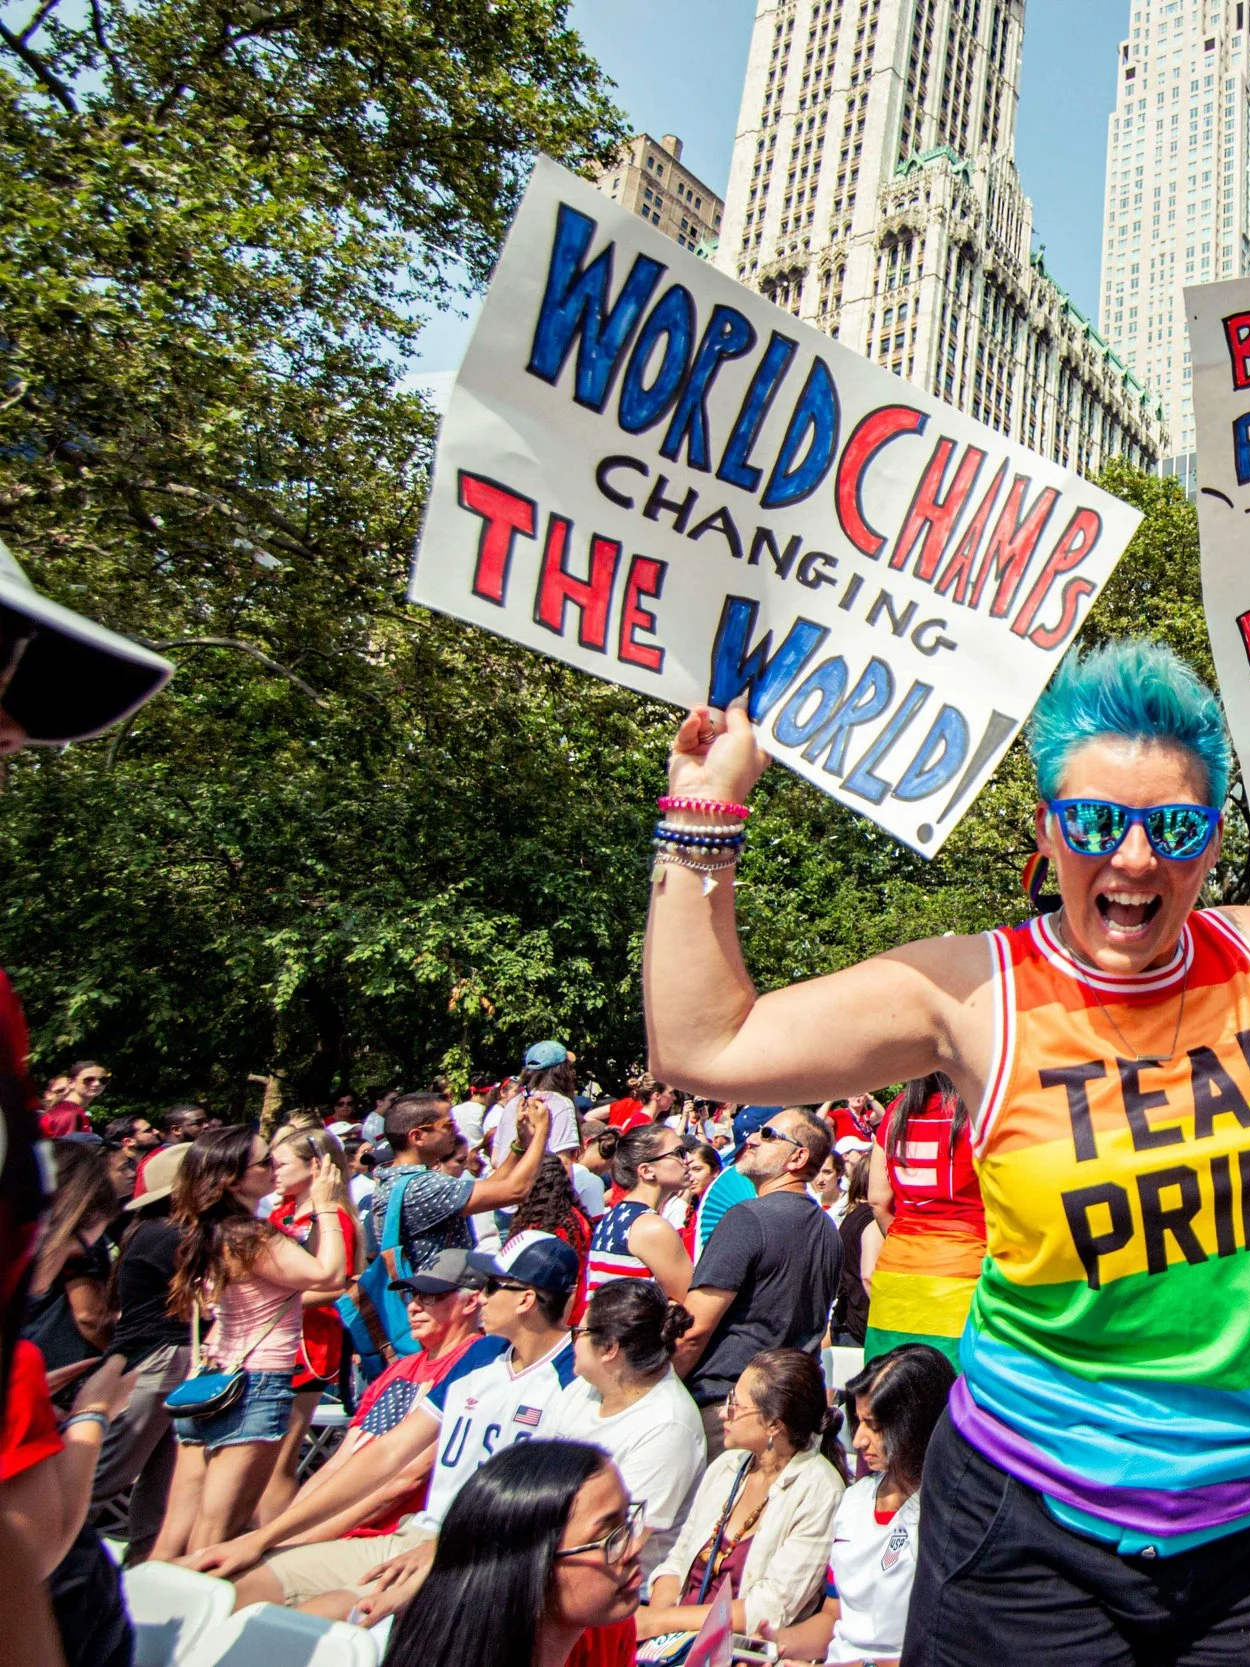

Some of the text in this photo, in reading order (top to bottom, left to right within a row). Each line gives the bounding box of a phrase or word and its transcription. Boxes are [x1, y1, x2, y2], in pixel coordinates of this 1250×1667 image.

[525, 201, 1102, 650] WORLD CHAMPS
[595, 455, 957, 657] CHANGING
[457, 470, 1019, 845] THE WORLD!
[441, 1415, 533, 1468] US
[890, 1538, 905, 1551] USA
